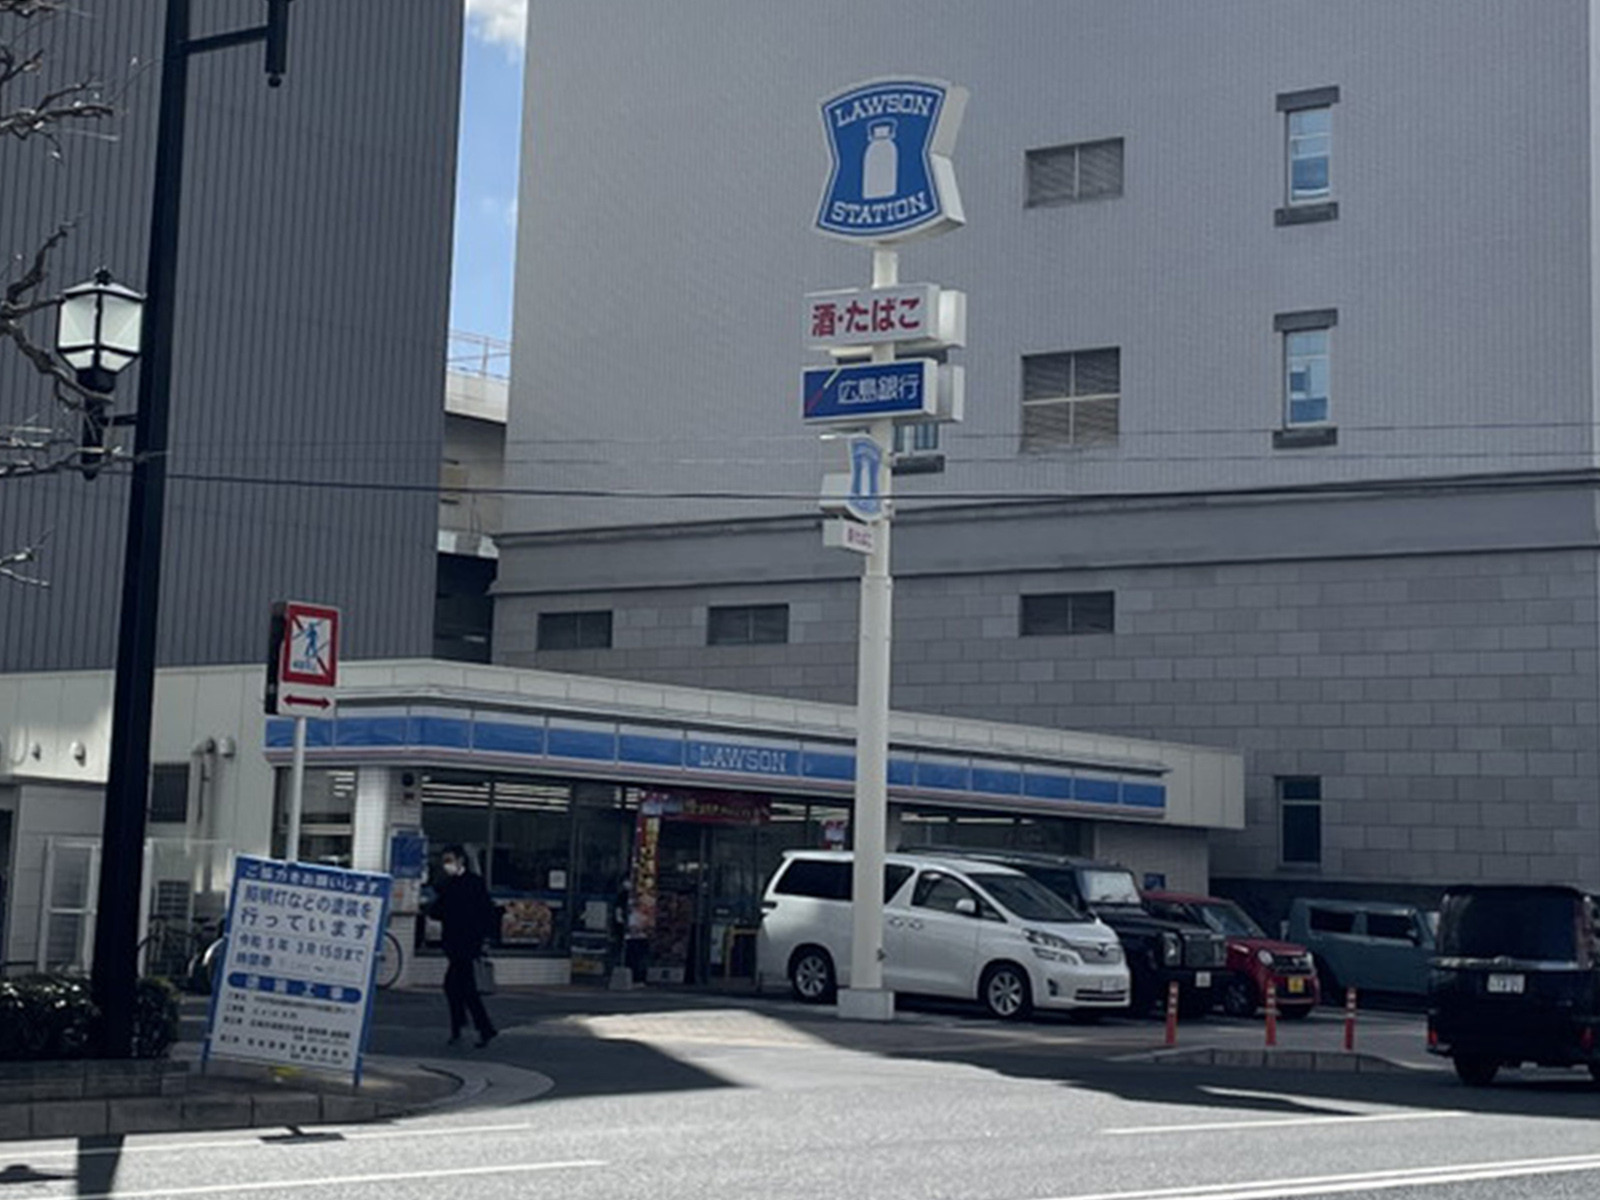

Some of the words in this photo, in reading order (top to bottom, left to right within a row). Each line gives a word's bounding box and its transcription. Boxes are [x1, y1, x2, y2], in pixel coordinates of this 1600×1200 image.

[835, 94, 933, 127] LAWSON
[831, 192, 928, 224] STATION
[837, 373, 919, 404] 広島銀行
[700, 744, 787, 773] LAWSON
[241, 909, 369, 940] 行っています
